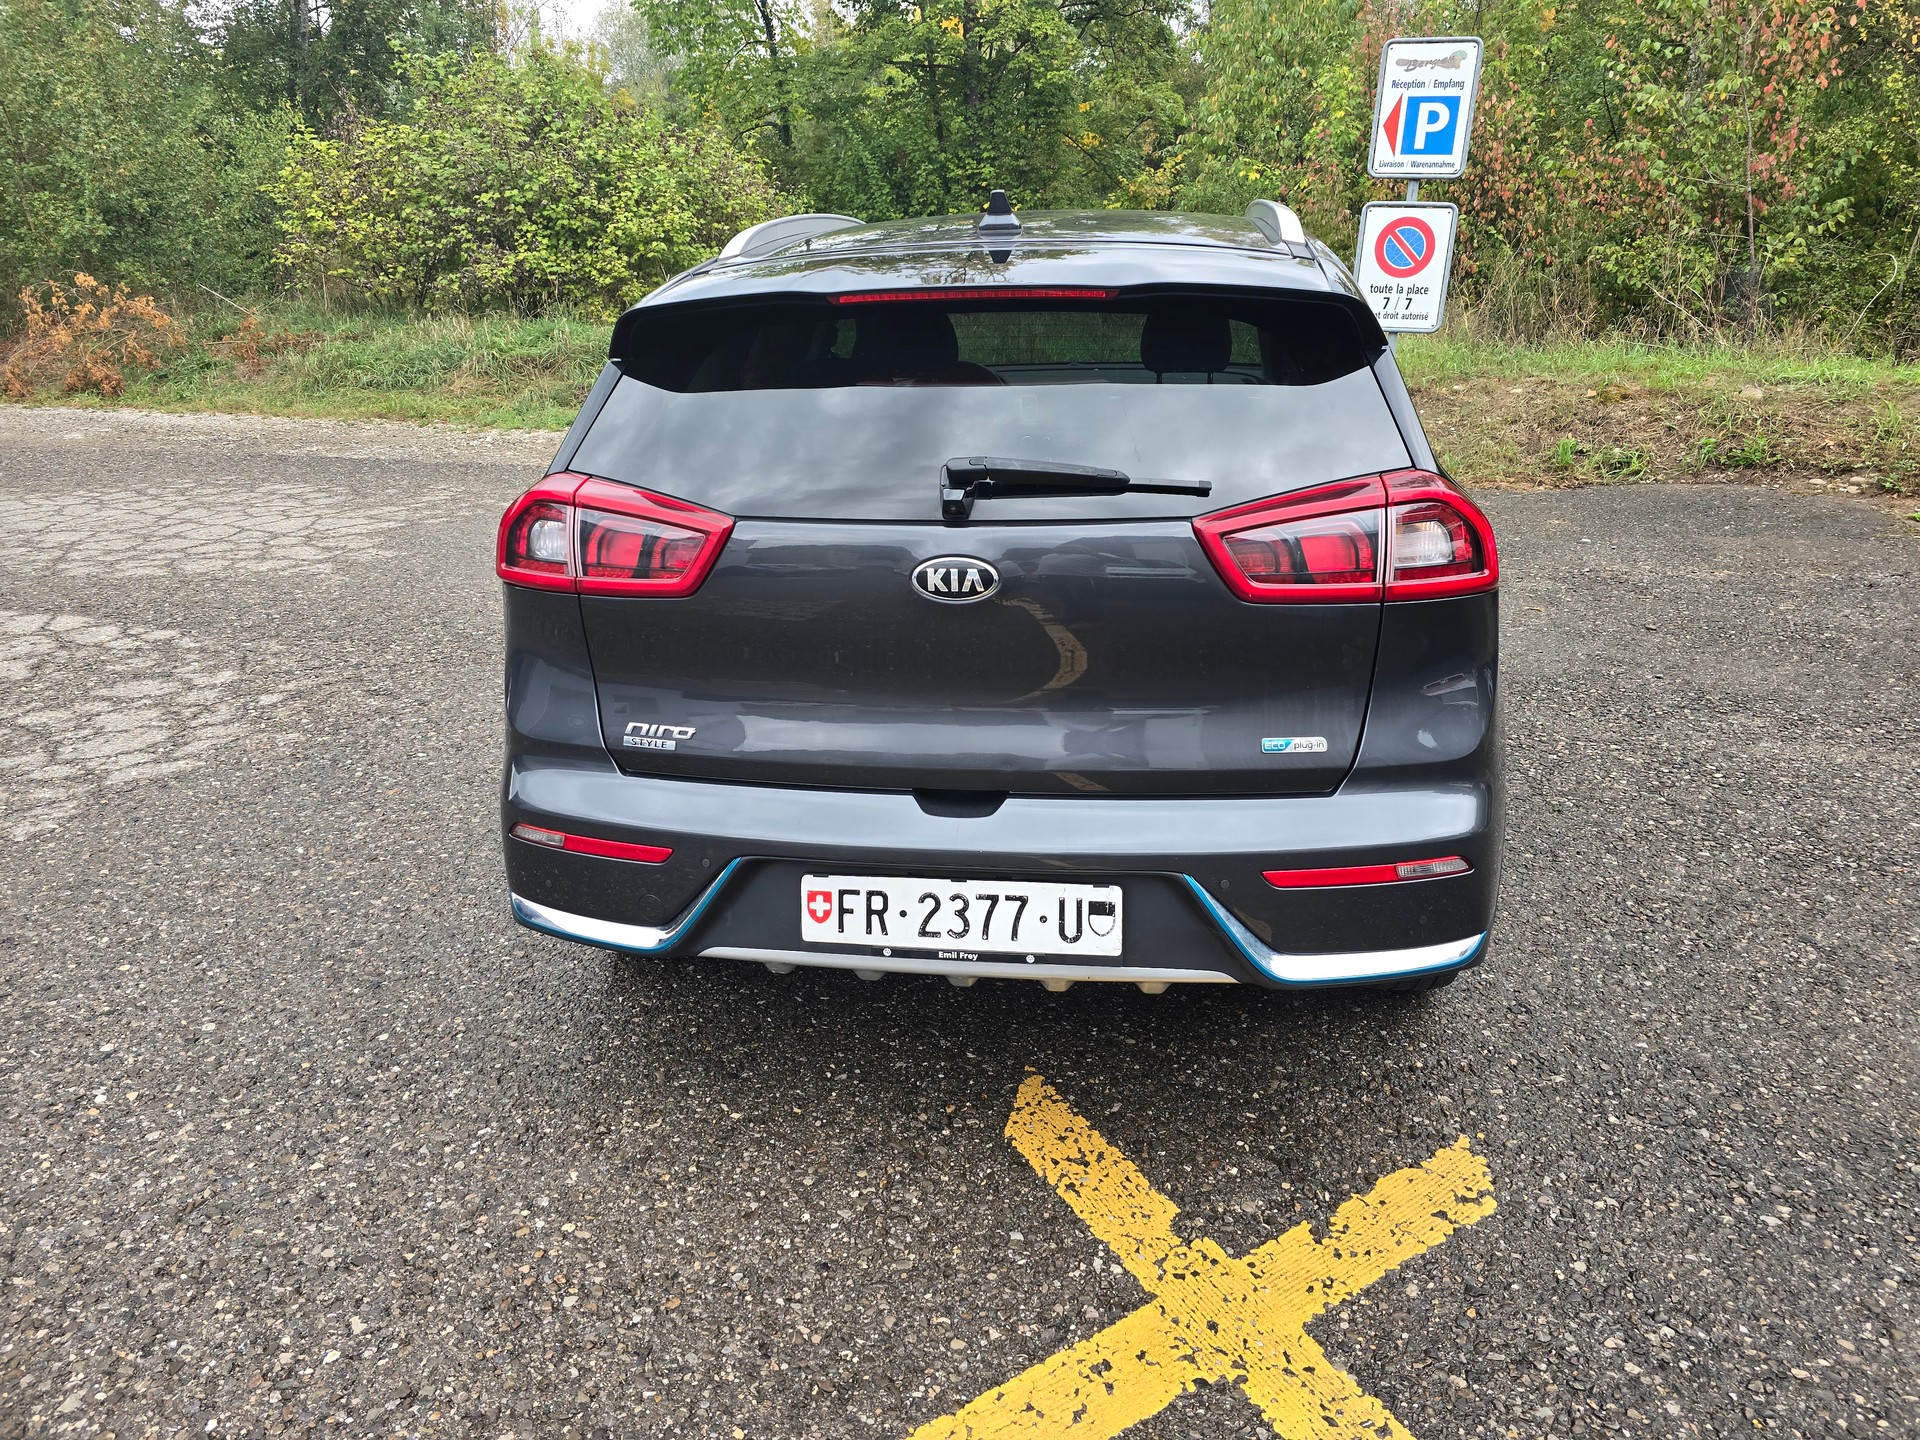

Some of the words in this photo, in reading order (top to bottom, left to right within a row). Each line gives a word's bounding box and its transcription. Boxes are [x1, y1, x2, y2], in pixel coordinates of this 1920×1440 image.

[1391, 79, 1426, 91] Réception
[1433, 78, 1465, 90] Empfang
[1413, 102, 1451, 150] P
[1379, 160, 1405, 168] Livraison
[1410, 160, 1456, 169] Warenannahme
[1370, 283, 1394, 294] toute
[1396, 283, 1404, 294] la
[1406, 283, 1429, 297] place
[1382, 311, 1399, 320] droit
[1400, 311, 1429, 321] autorisé
[925, 567, 985, 592] KIA
[631, 737, 668, 749] STYLE
[1293, 741, 1325, 751] plug-in
[938, 950, 958, 959] Emil
[959, 951, 979, 961] Frey
